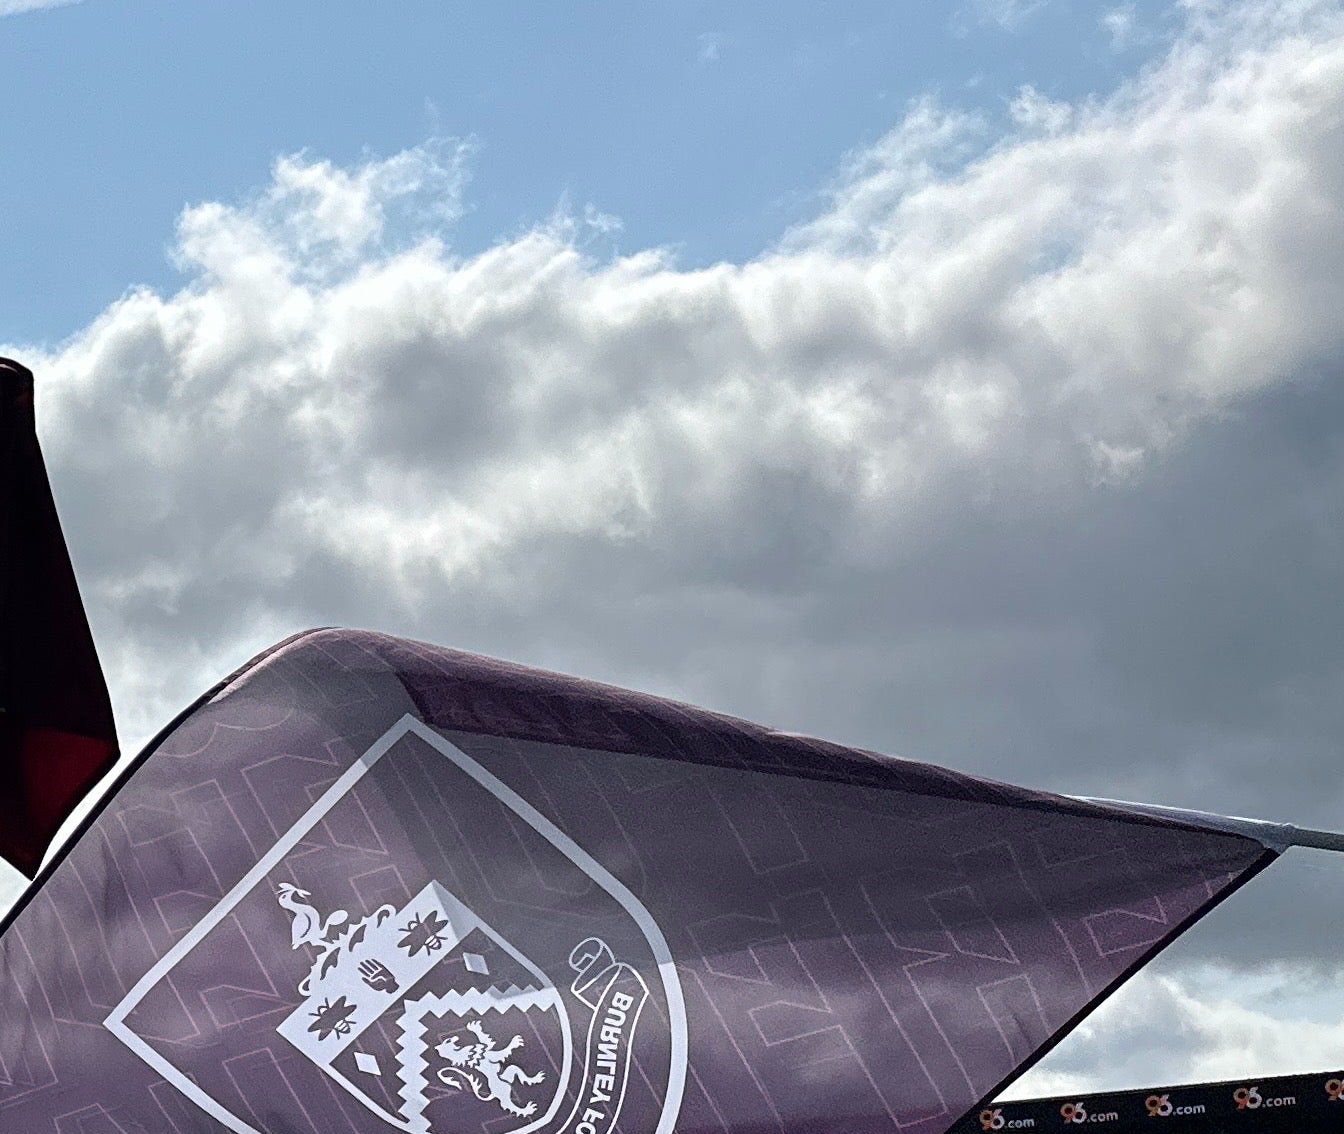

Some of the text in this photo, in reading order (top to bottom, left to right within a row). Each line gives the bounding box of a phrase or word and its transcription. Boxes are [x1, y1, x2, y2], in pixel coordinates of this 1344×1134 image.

[979, 1108, 1035, 1132] 96.com
[1060, 1102, 1119, 1124] 96.com
[1145, 1094, 1206, 1117] 96.com
[1233, 1086, 1296, 1110] 96.com
